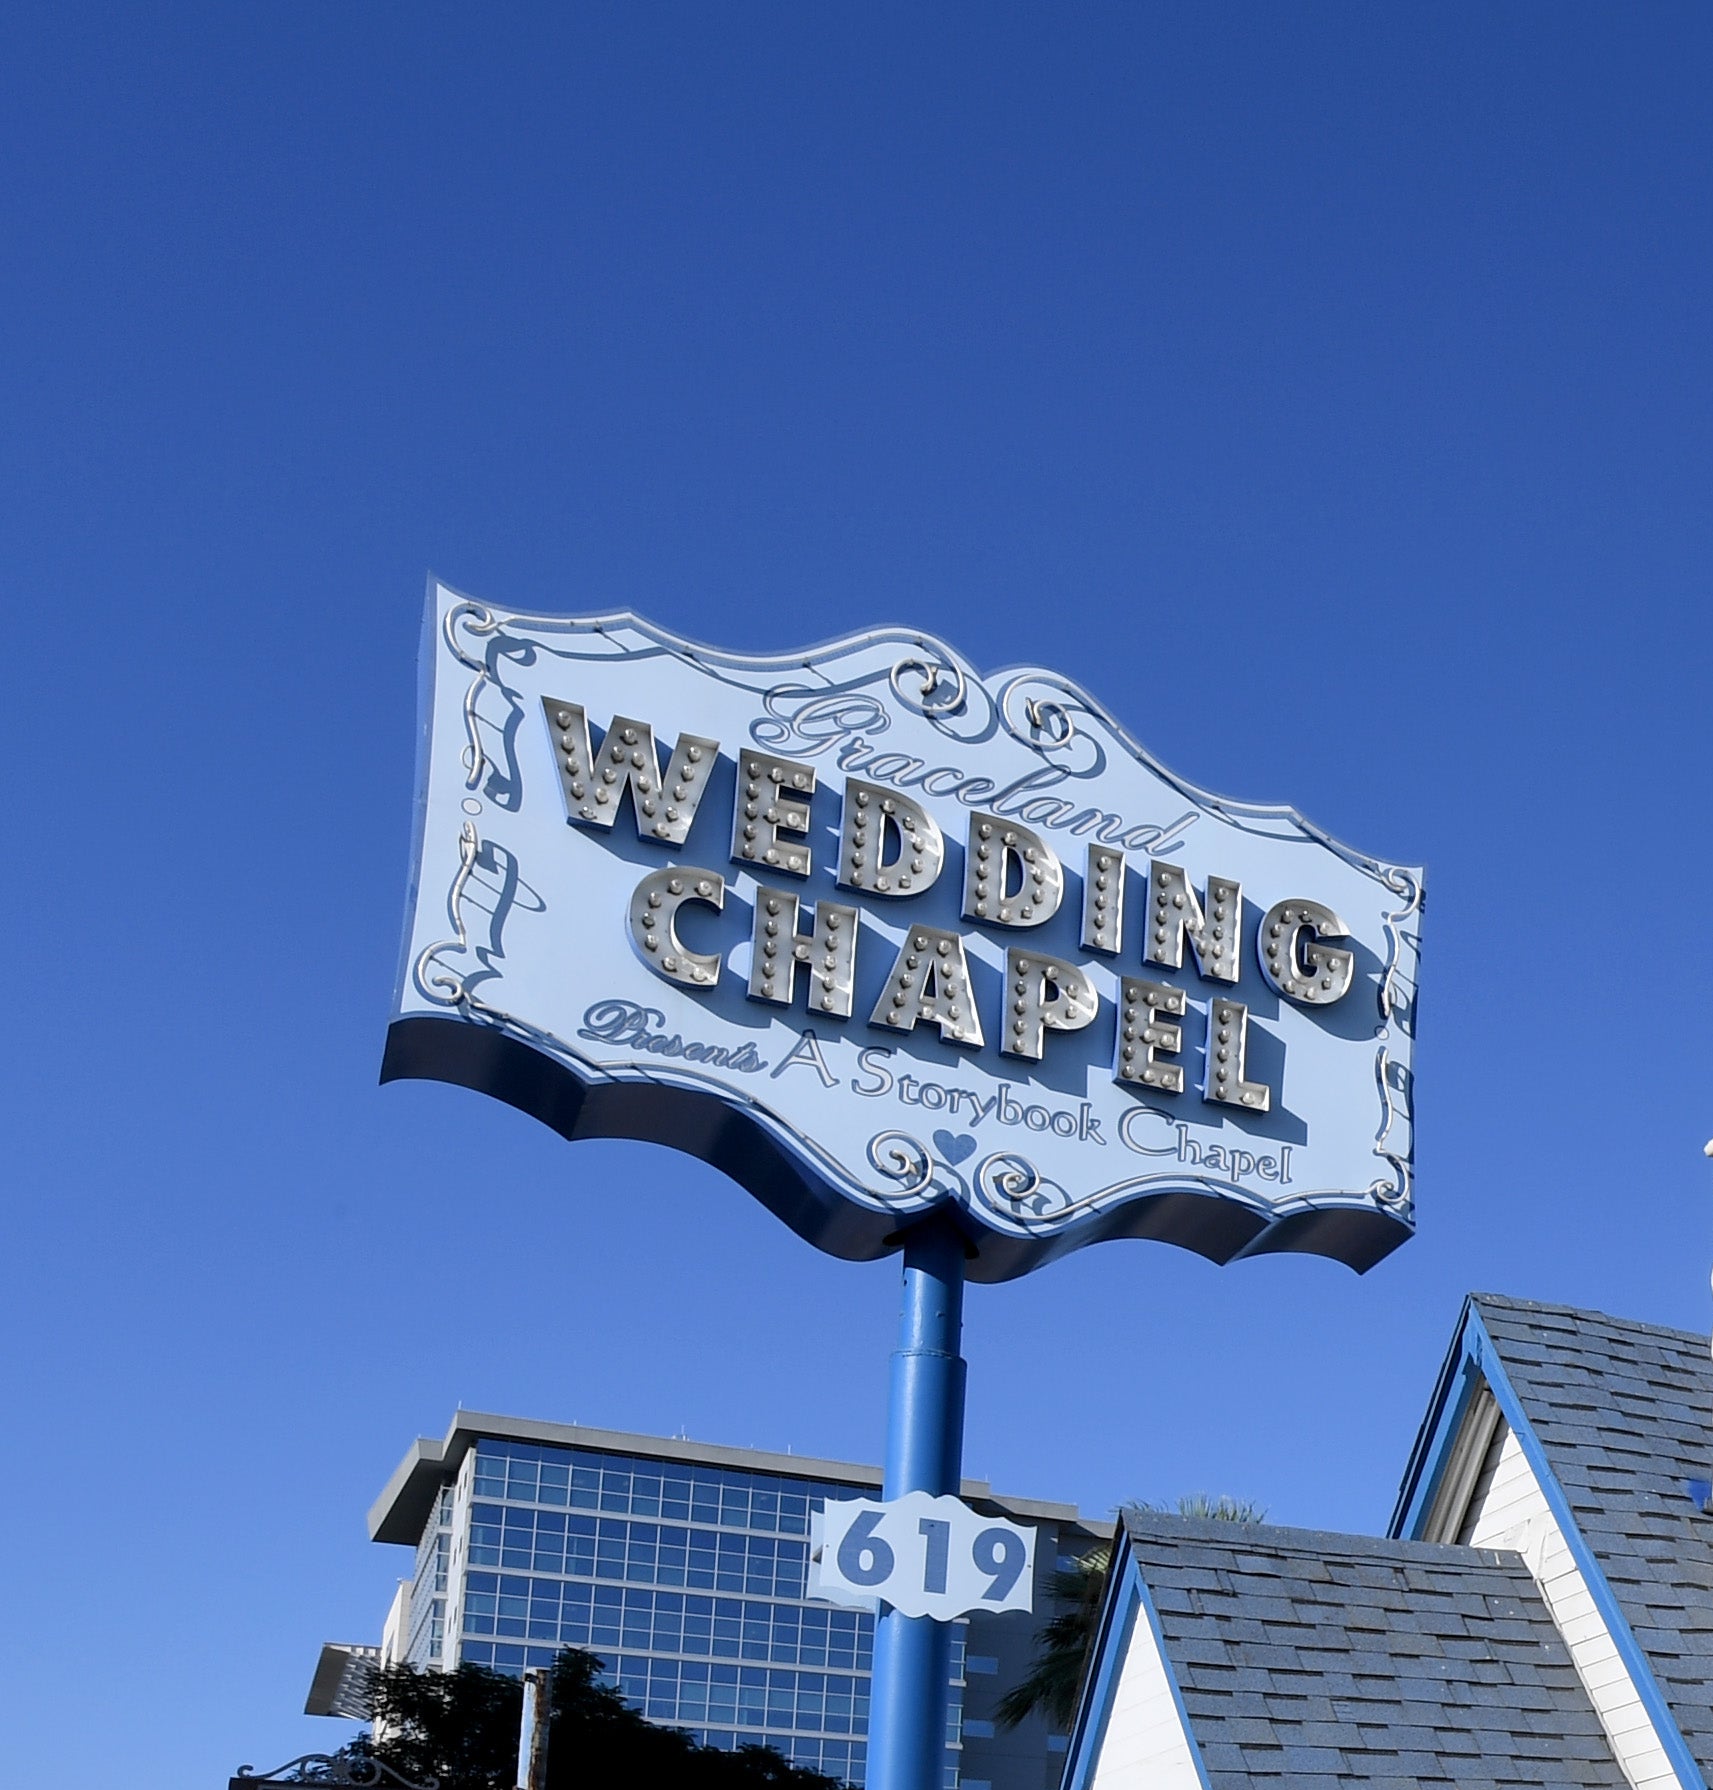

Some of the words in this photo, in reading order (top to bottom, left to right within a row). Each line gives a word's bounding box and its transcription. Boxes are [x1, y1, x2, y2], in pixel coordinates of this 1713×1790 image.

[540, 695, 1354, 1005] WEDDING
[749, 683, 1200, 857] Graceland
[628, 866, 1271, 1113] CHAPEL
[576, 999, 768, 1075] Presents
[771, 1030, 839, 1089] A
[851, 1047, 1107, 1147] Storybook
[1116, 1105, 1293, 1185] Chapel
[837, 1510, 1026, 1602] 619
